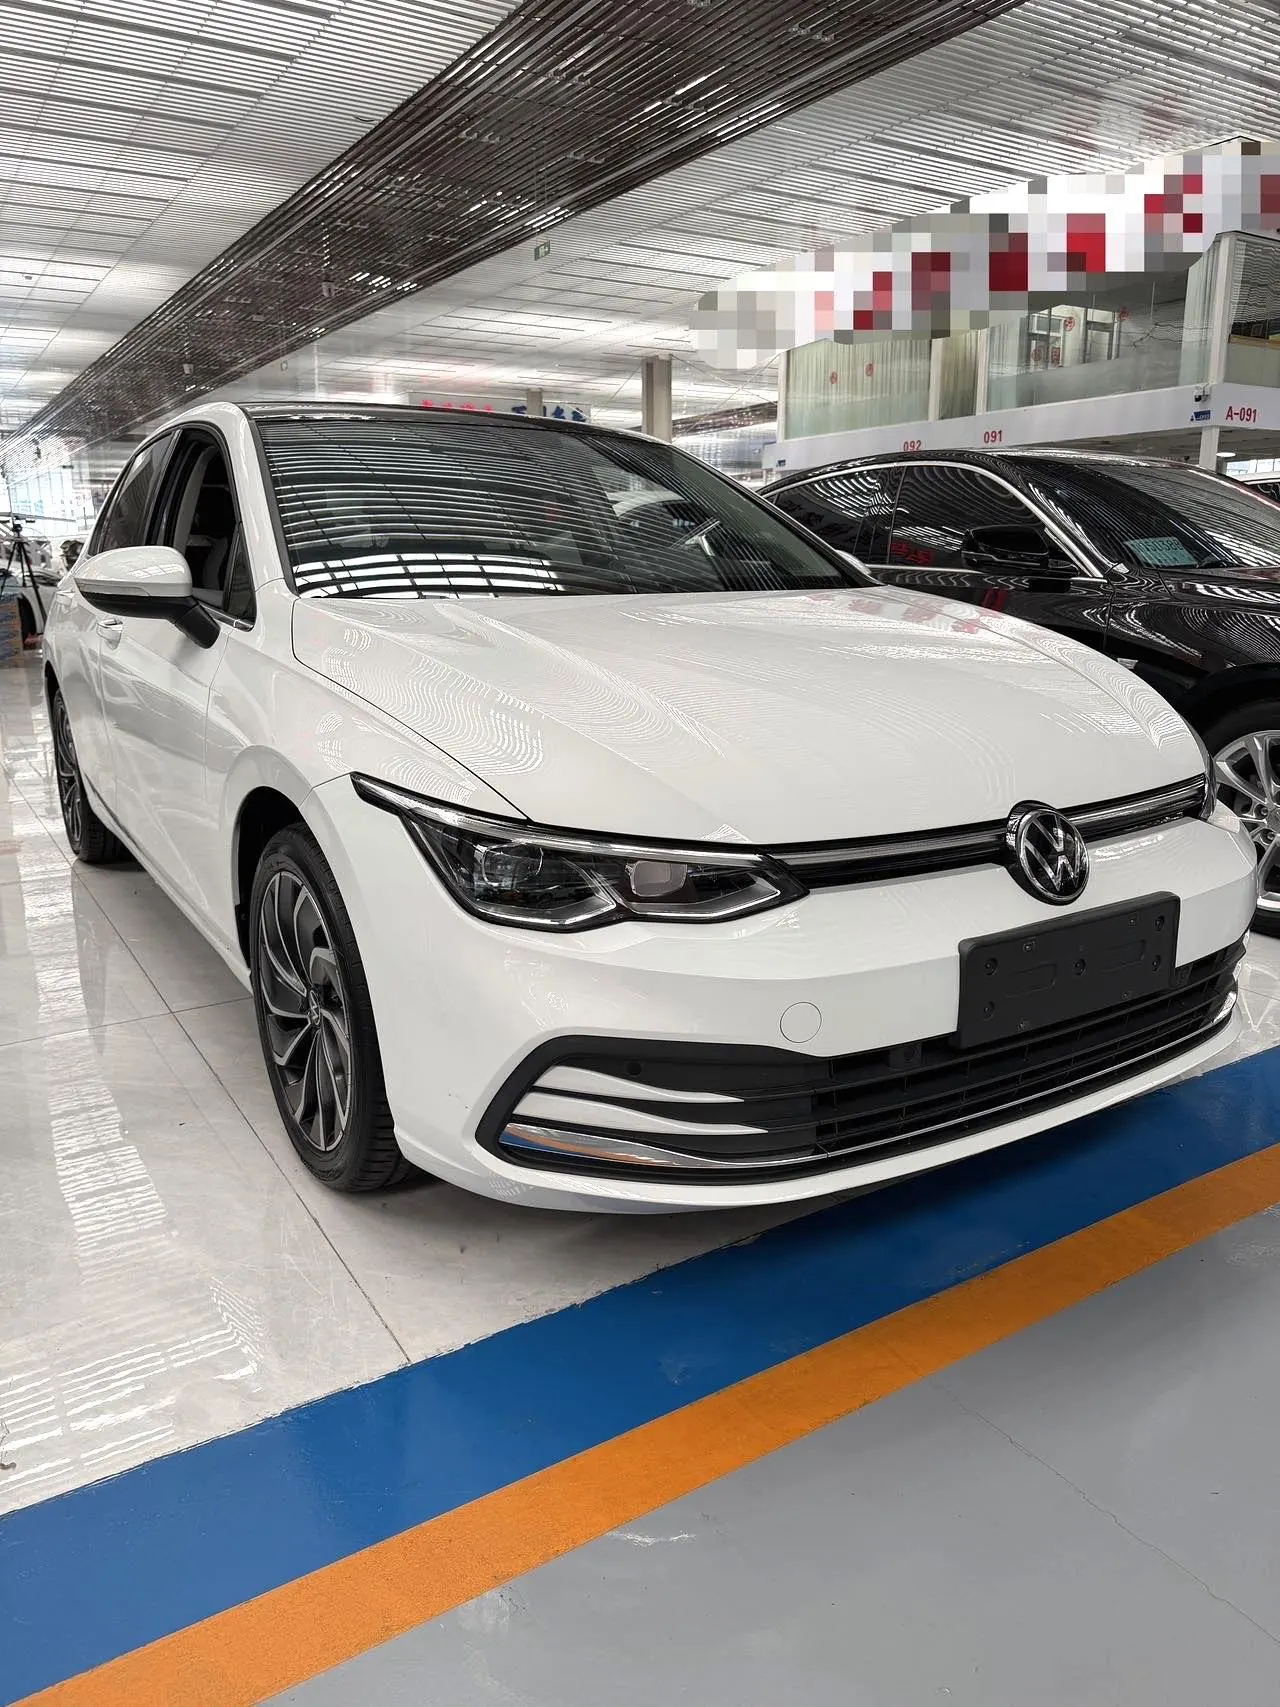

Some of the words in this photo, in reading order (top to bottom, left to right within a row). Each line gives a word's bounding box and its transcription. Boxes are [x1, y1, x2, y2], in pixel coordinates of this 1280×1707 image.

[1225, 405, 1257, 422] A-091
[983, 430, 1002, 443] 091
[903, 440, 921, 452] 092
